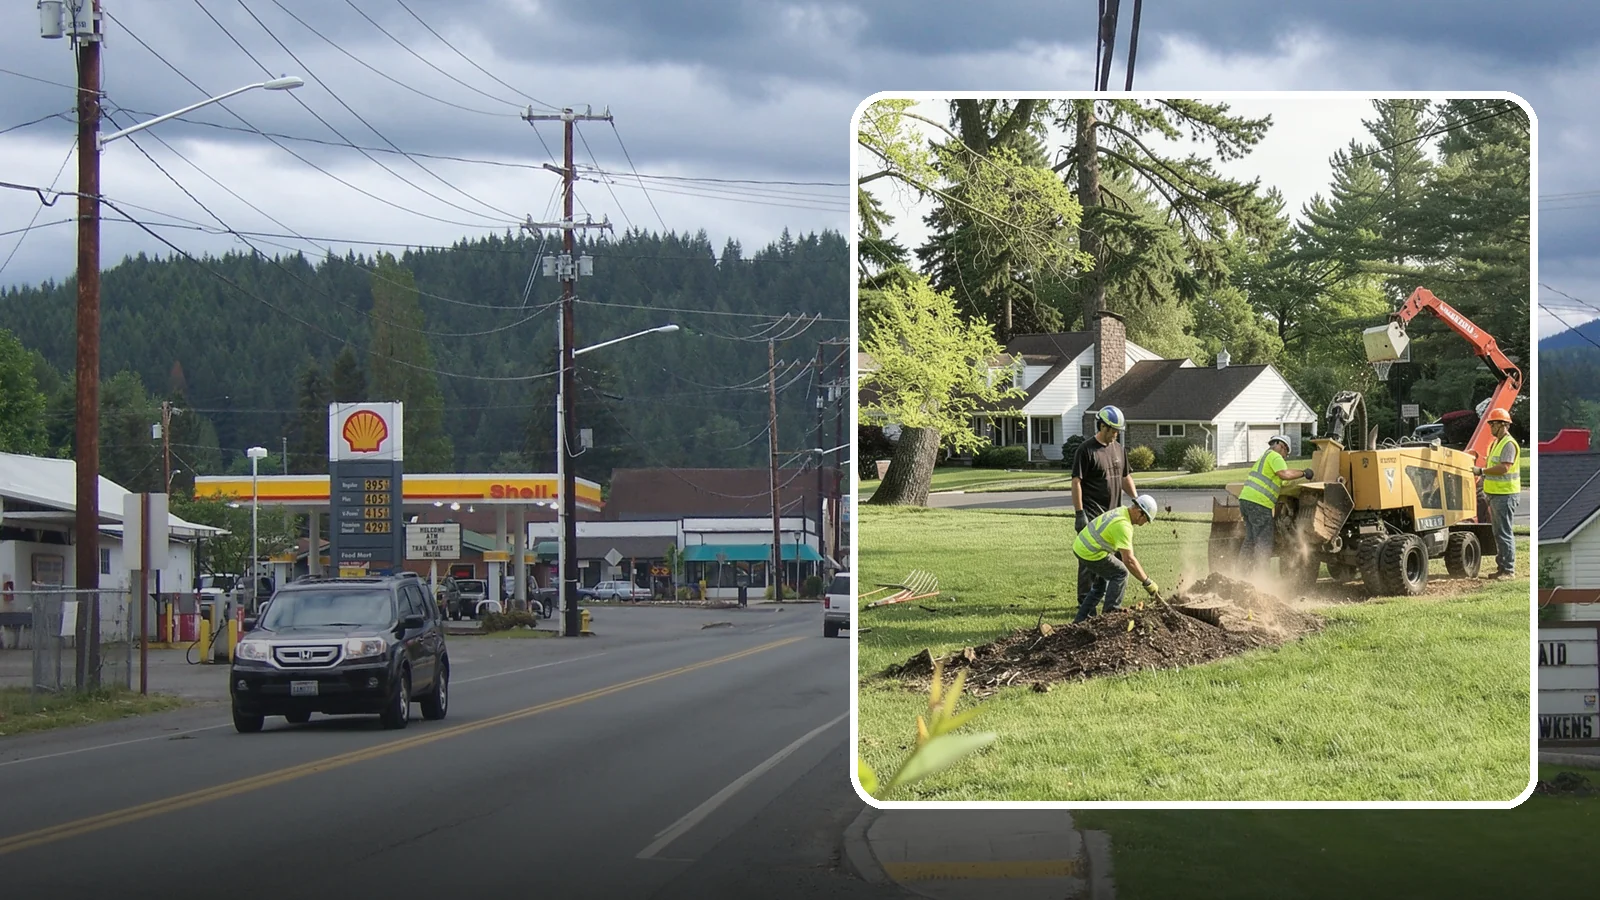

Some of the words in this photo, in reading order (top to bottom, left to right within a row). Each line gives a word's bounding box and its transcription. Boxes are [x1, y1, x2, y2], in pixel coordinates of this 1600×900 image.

[366, 480, 384, 490] 395
[490, 484, 547, 499] Shell
[366, 494, 384, 504] 405
[366, 508, 384, 518] 415
[366, 522, 384, 532] 429
